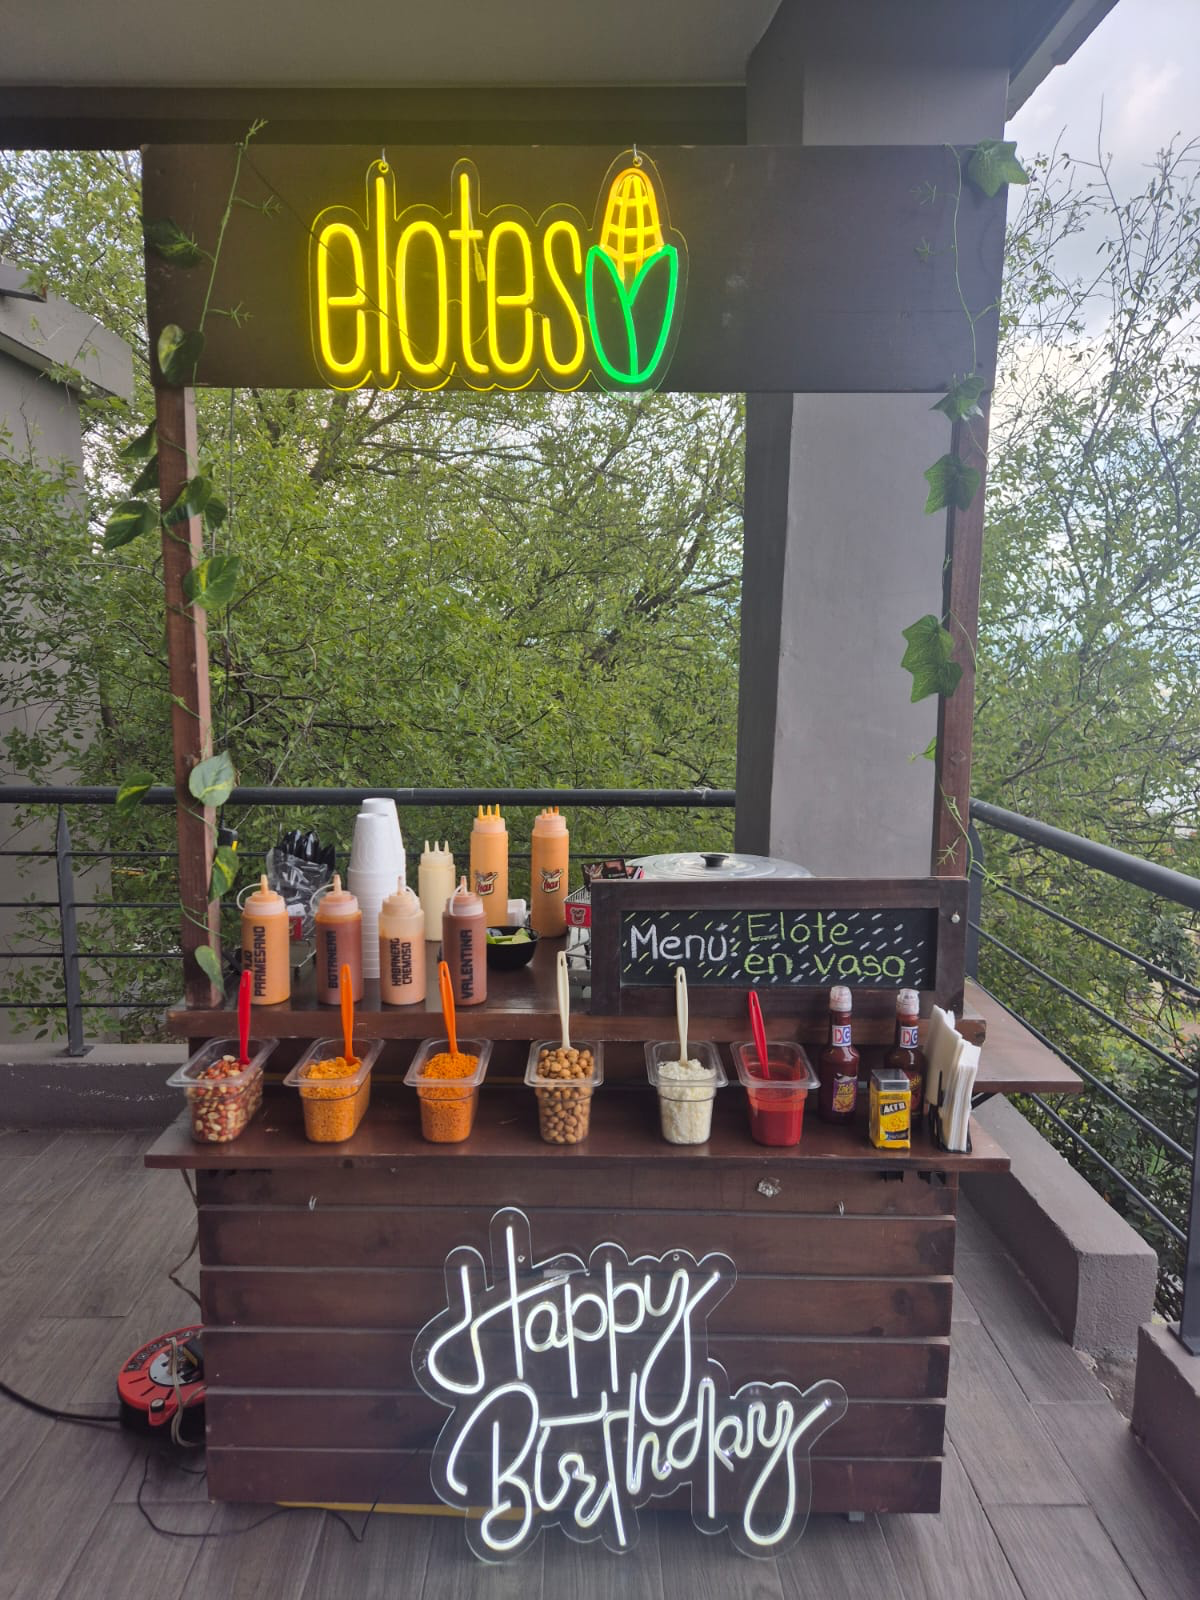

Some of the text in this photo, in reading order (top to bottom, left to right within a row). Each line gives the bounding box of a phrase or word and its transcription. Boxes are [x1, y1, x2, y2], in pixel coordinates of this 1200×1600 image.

[317, 173, 586, 376] elotes
[253, 925, 267, 997] PARMESANO
[328, 930, 339, 989] BOTANERA
[401, 941, 413, 985] CREMOSO
[746, 911, 855, 946] Elote
[460, 929, 473, 999] VALENTINA
[743, 952, 906, 978] en vaso
[428, 1226, 721, 1426] Happy
[447, 1372, 831, 1550] Birthday
